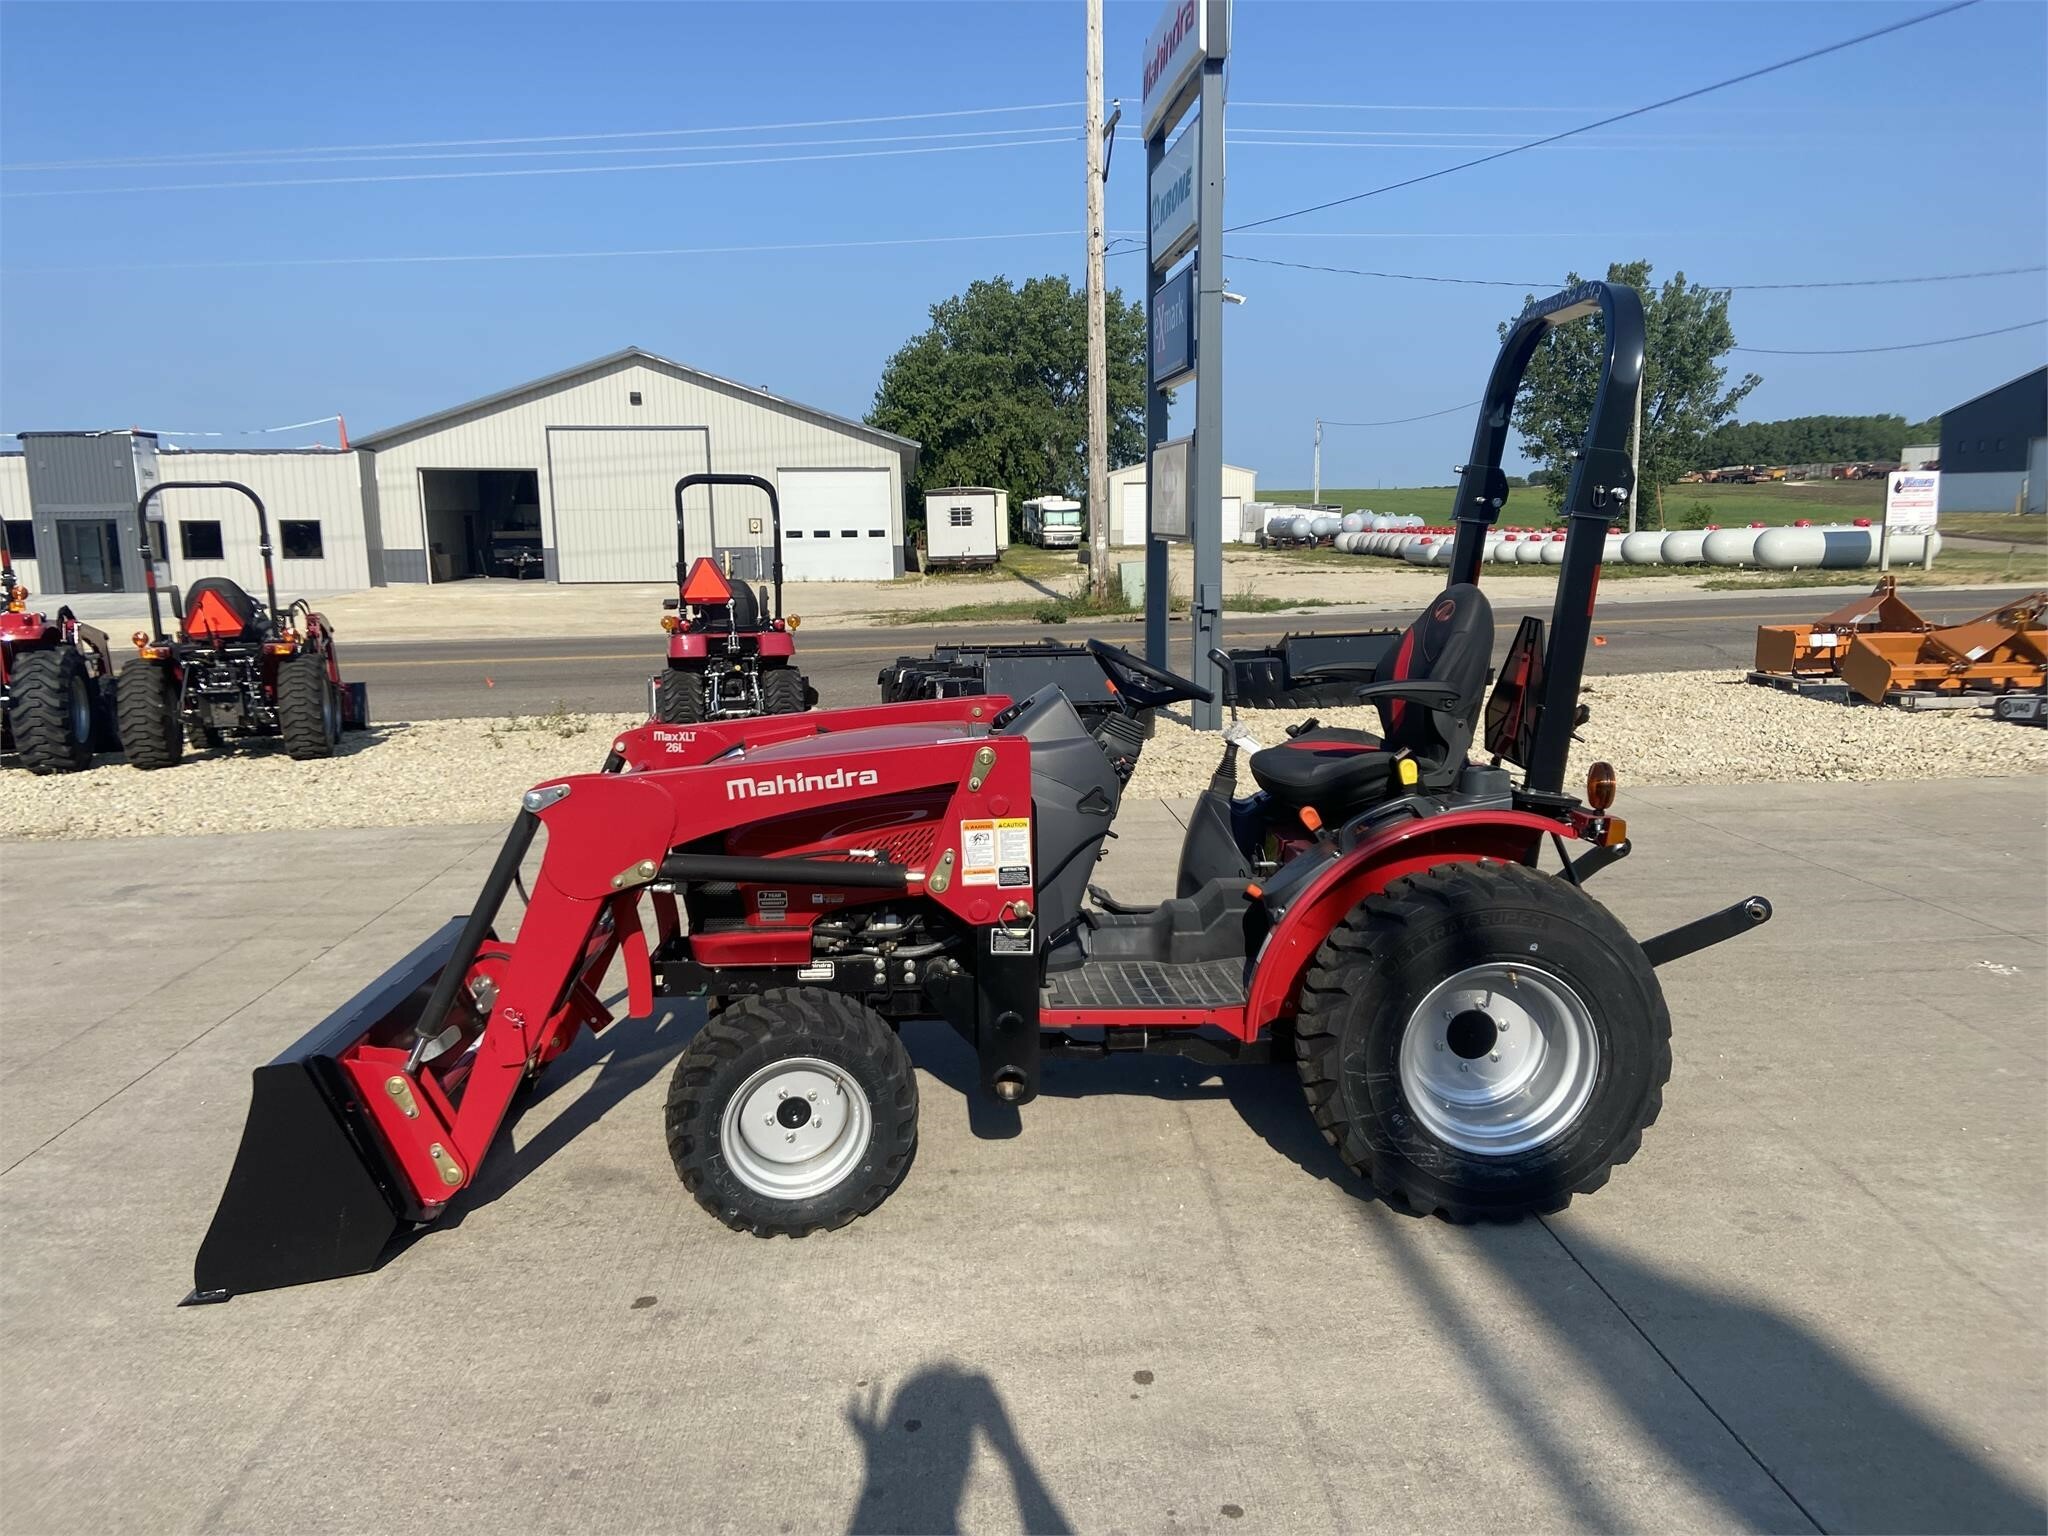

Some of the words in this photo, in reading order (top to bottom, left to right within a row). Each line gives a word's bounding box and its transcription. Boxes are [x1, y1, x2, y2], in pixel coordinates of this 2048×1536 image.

[1143, 0, 1195, 104] Mahindra
[1159, 165, 1192, 227] KRONE
[653, 731, 696, 743] MaxXLT
[665, 743, 685, 753] 26L
[726, 768, 878, 800] Mahindra
